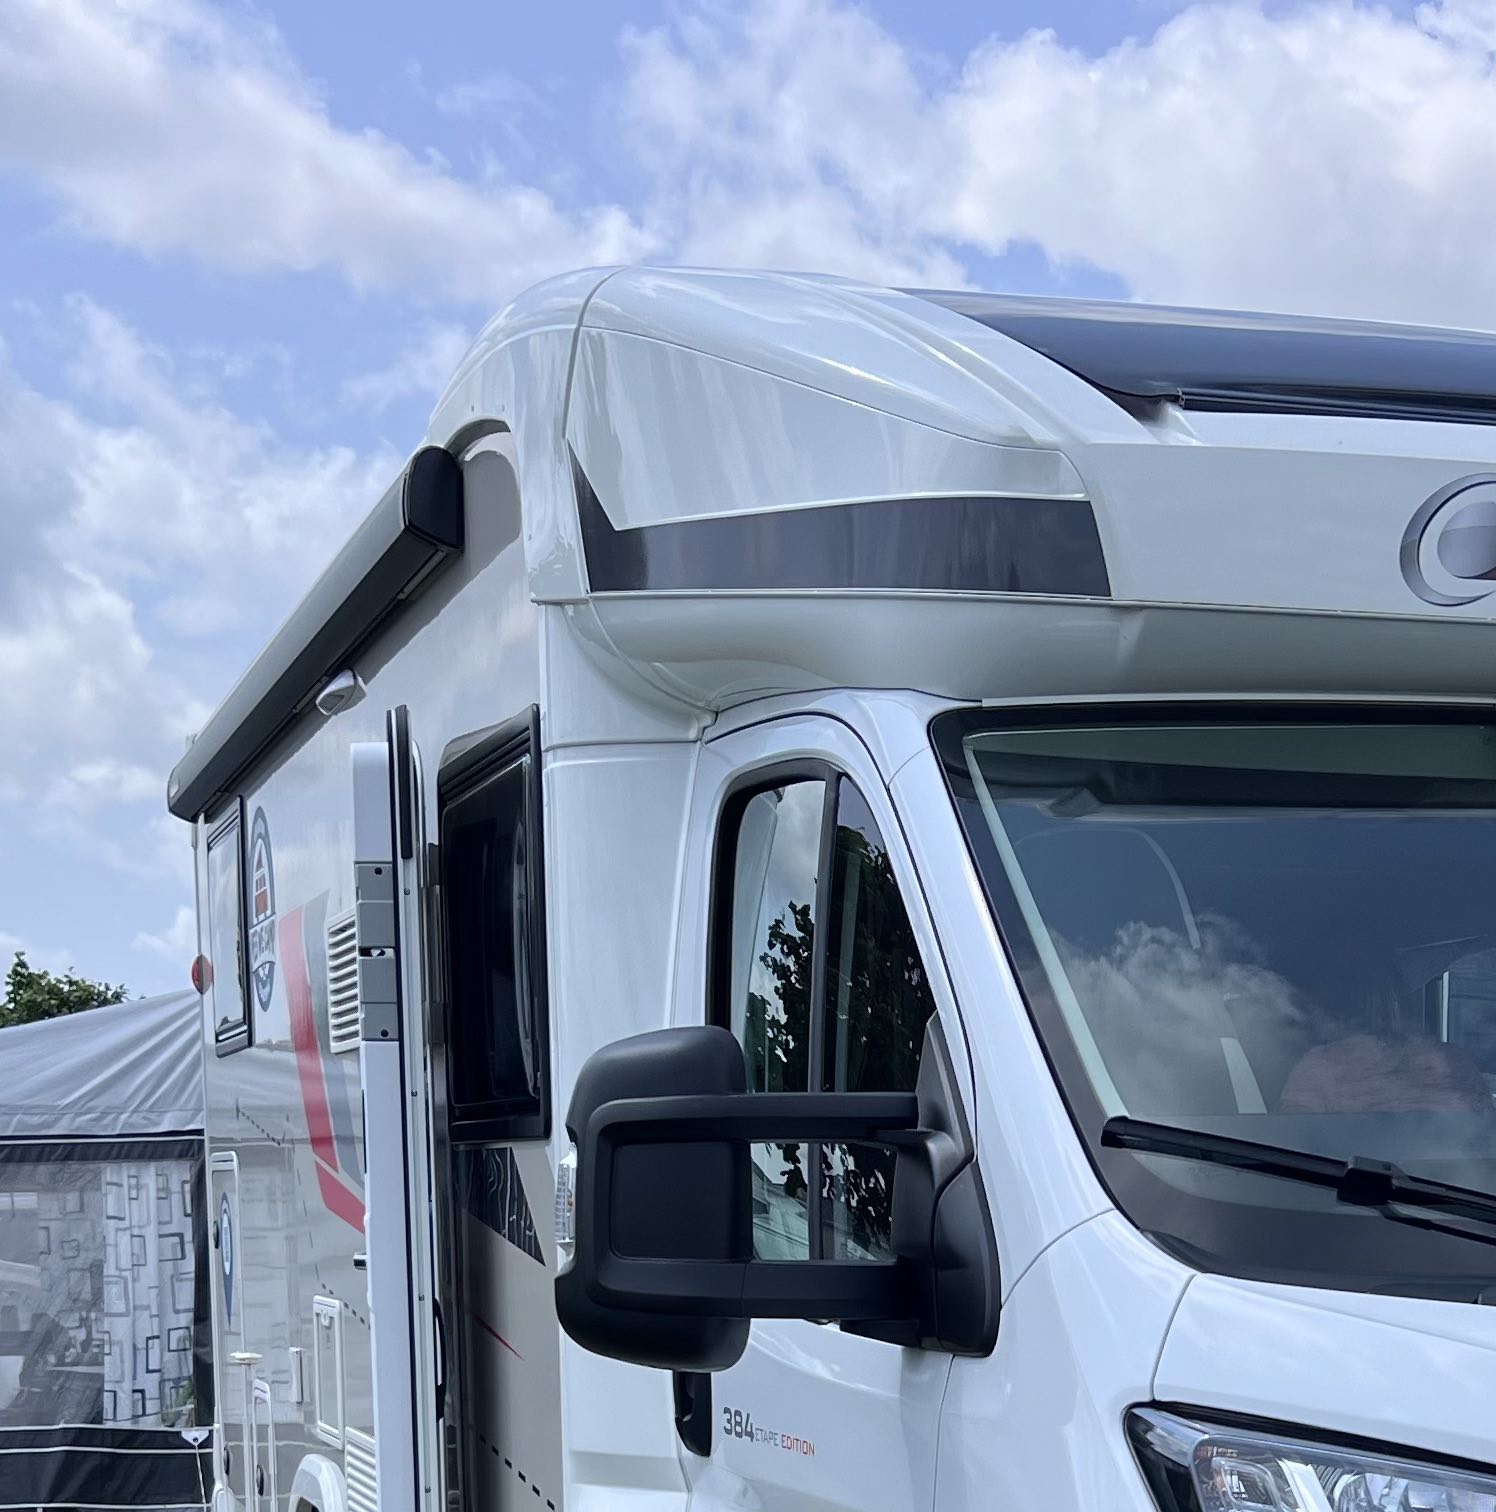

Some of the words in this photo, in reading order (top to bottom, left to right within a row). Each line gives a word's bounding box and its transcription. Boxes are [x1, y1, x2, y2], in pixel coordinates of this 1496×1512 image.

[723, 1406, 755, 1442] 384
[755, 1427, 779, 1447] ETAPE
[780, 1433, 816, 1456] EDITION
